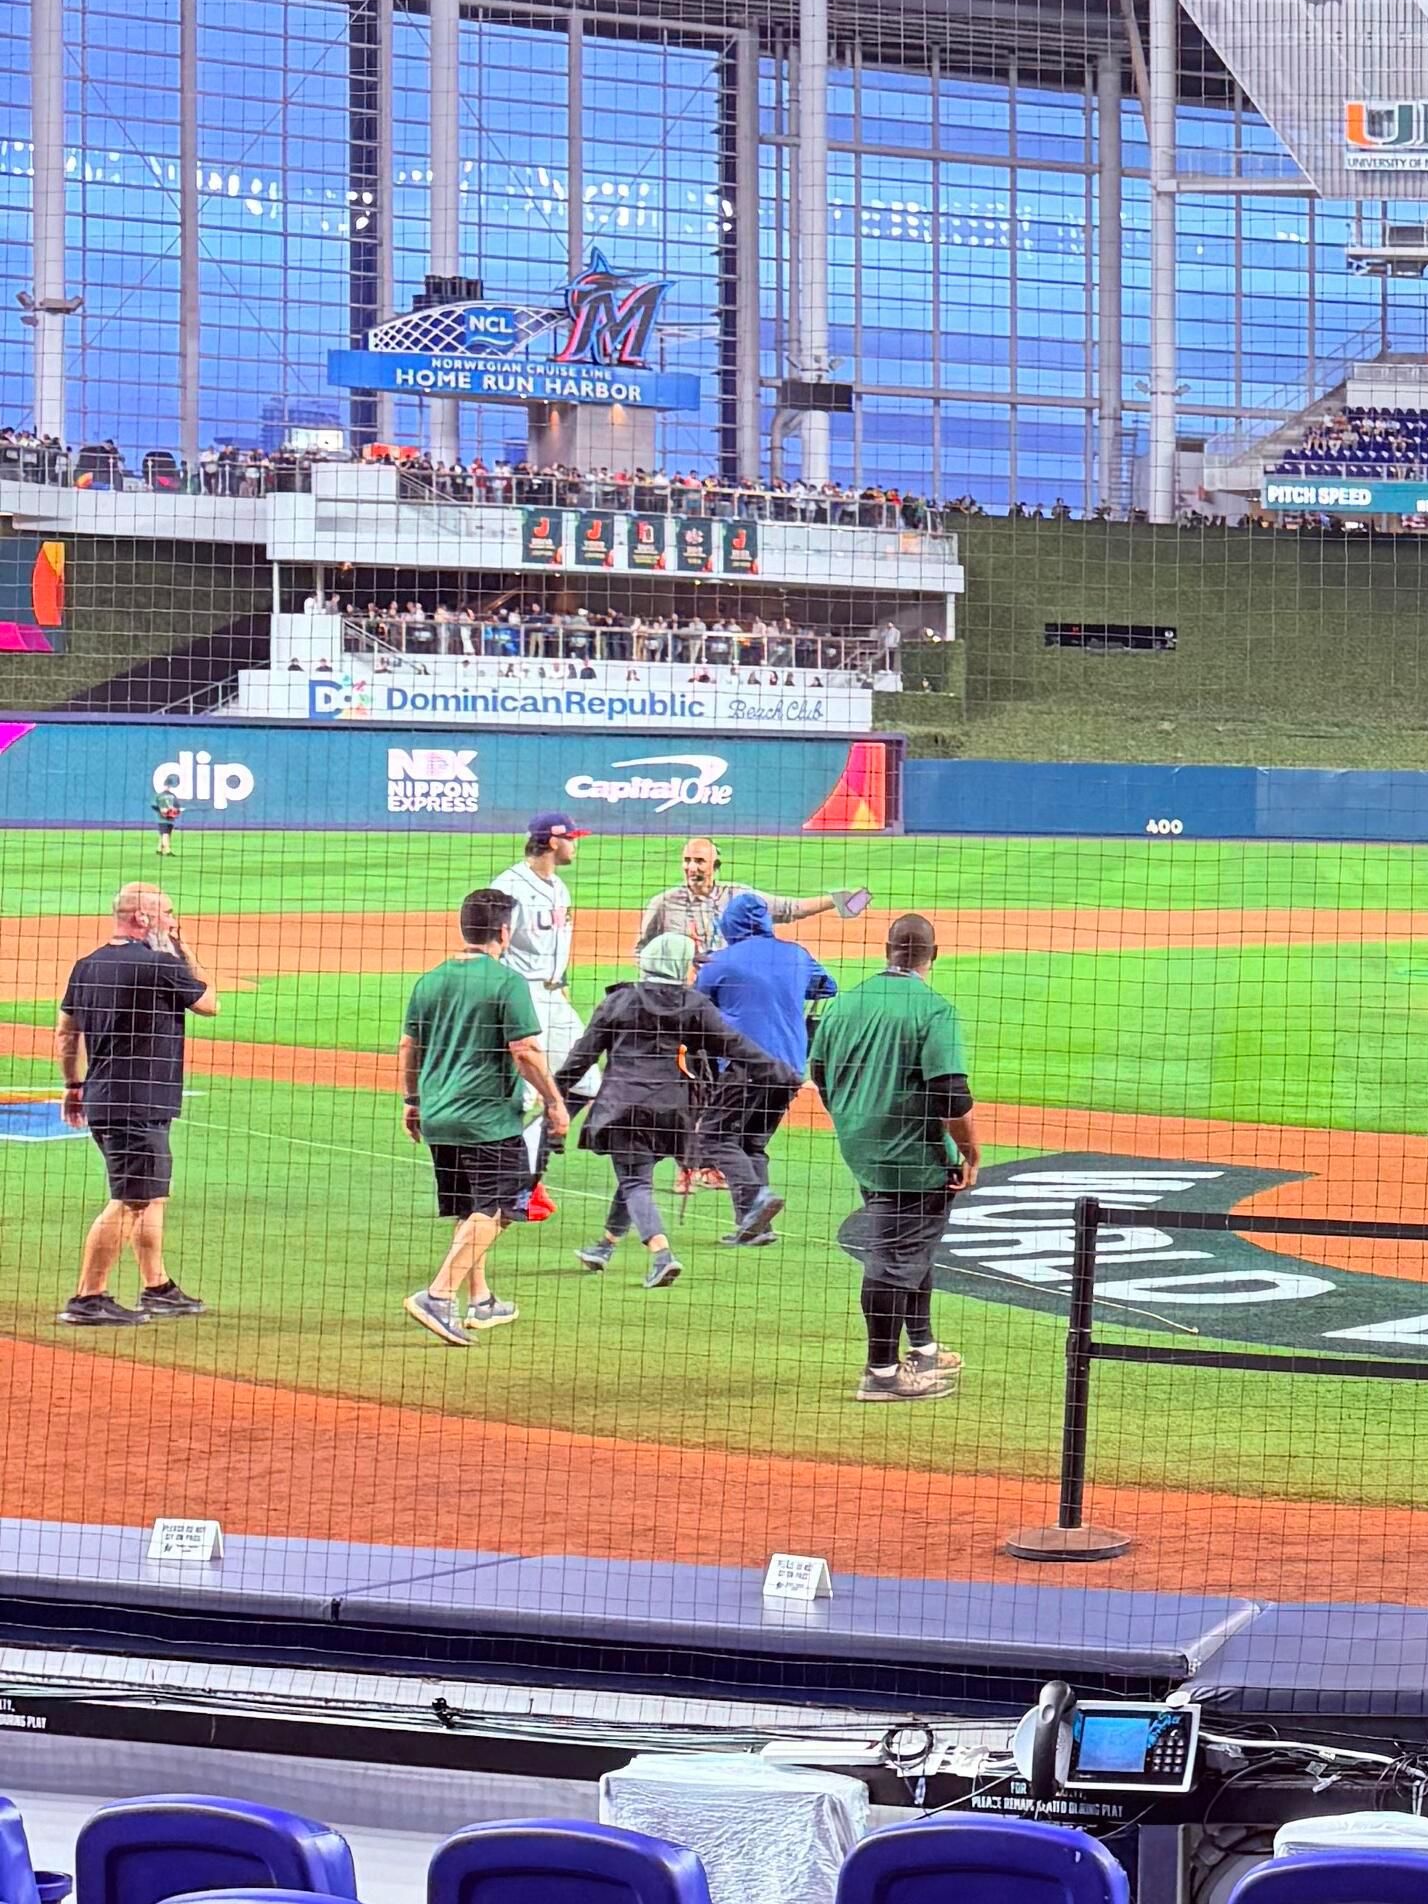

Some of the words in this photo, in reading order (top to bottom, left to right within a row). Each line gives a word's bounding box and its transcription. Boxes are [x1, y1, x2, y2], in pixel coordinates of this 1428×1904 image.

[1347, 157, 1405, 169] UNIVERSITY
[1408, 157, 1422, 169] OF
[468, 315, 514, 334] NCL
[431, 357, 522, 374] NORWEGIAN
[526, 365, 578, 377] CRUISE
[581, 369, 612, 381] LINE
[395, 368, 472, 390] HOME
[482, 373, 535, 393] RUN
[545, 379, 642, 401] HARBOR
[1267, 485, 1316, 504] PITCH
[1317, 487, 1372, 506] SPEED
[152, 751, 254, 810] dip
[387, 780, 479, 798] NIPPON
[387, 796, 479, 813] EXPRESS
[1145, 818, 1185, 836] 400
